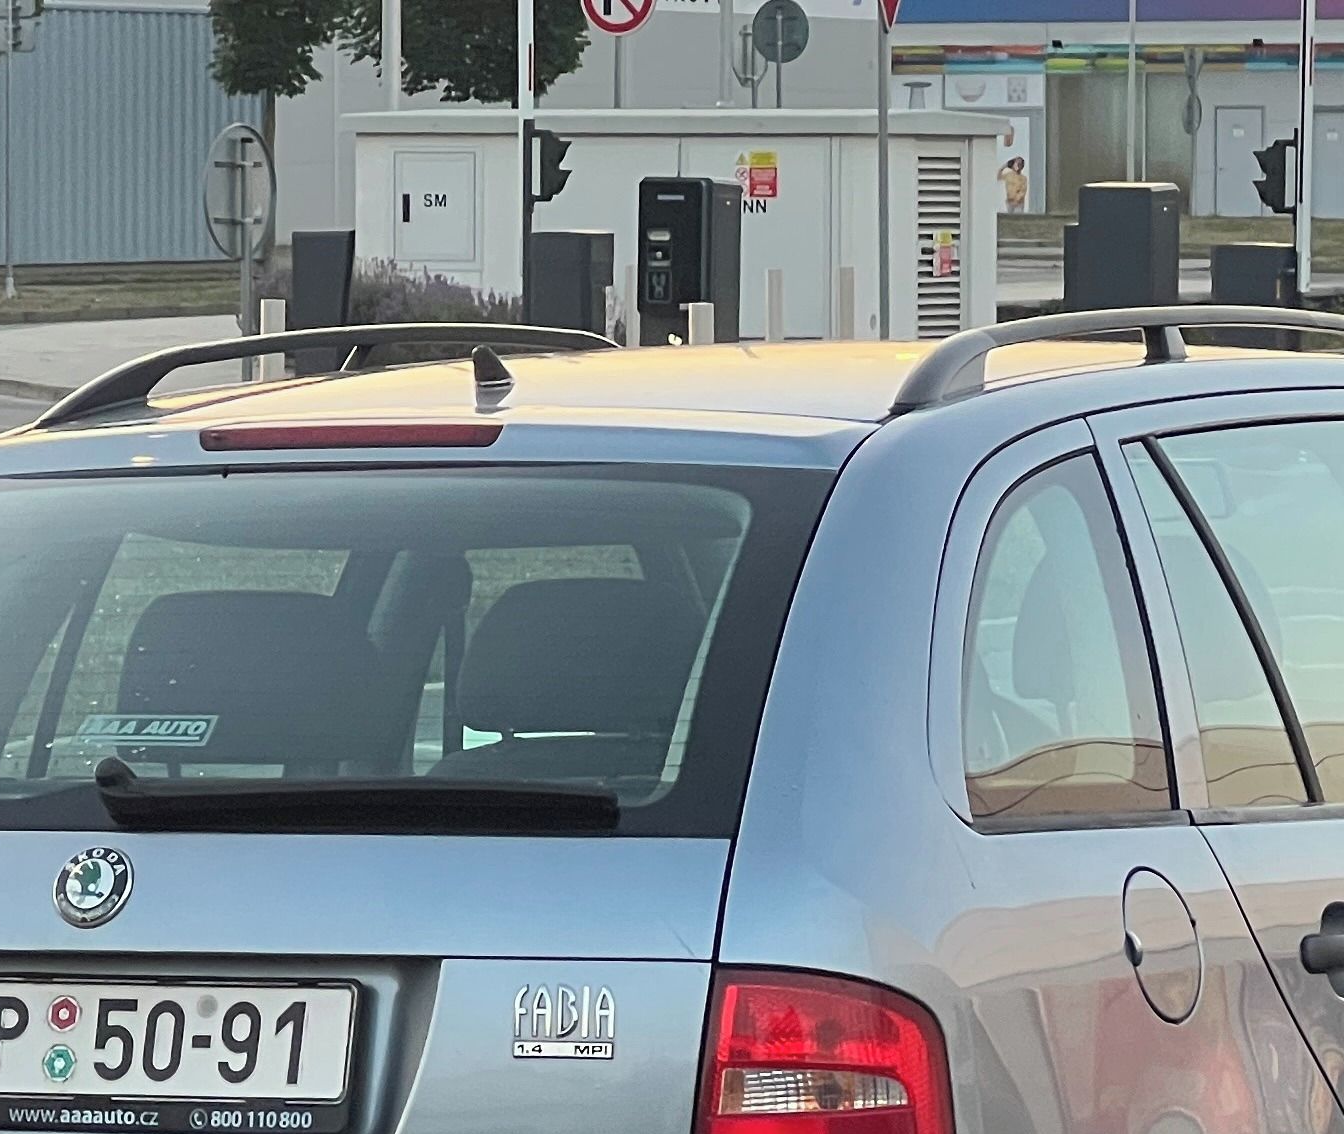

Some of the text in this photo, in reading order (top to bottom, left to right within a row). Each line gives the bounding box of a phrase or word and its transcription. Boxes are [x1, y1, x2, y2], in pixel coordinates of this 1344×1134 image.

[424, 193, 447, 207] SM
[743, 199, 767, 213] NN
[141, 720, 207, 735] AUTO
[514, 984, 615, 1039] FABIA
[93, 998, 308, 1086] 50-91
[517, 1045, 608, 1055] 1.4 MPI
[8, 1108, 159, 1127] www.aaaauto.cz
[210, 1110, 312, 1128] 800 110 800
